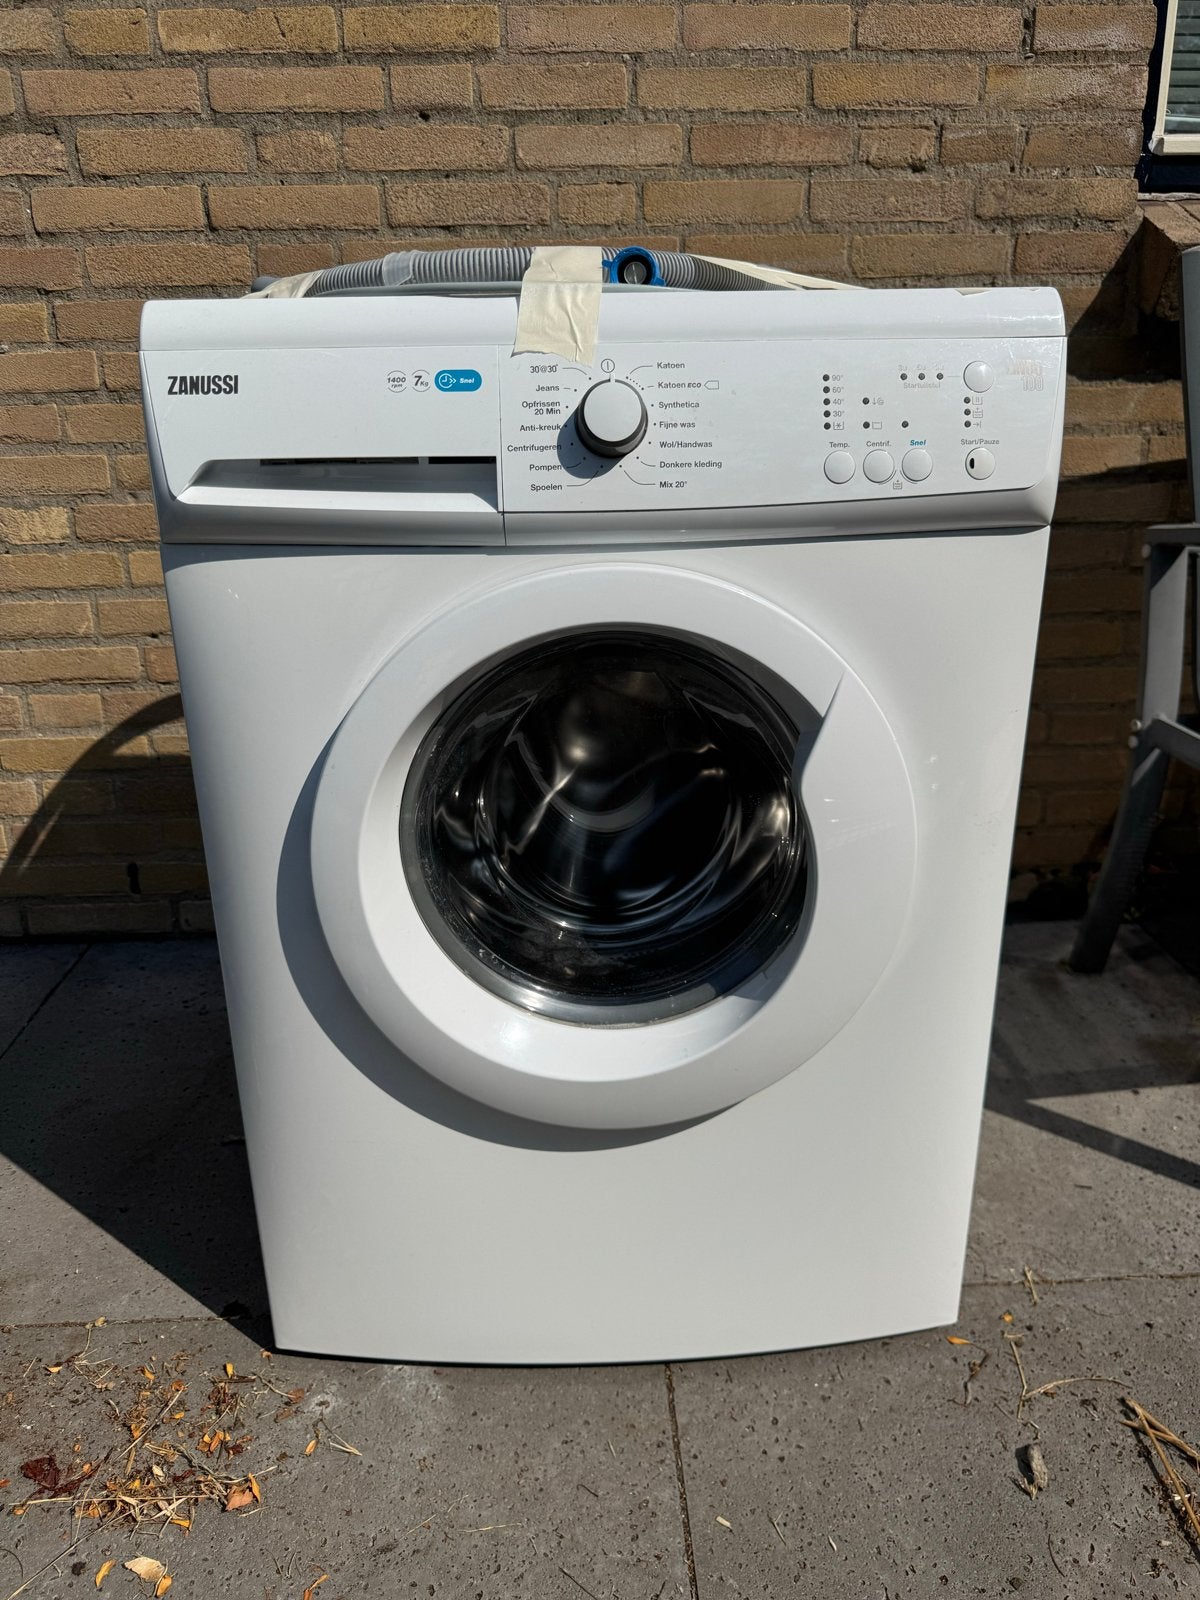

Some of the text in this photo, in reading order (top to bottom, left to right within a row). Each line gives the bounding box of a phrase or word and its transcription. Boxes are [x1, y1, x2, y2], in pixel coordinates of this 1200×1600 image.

[168, 375, 239, 395] ZANUSSI
[522, 400, 560, 409] Opfrissen
[658, 401, 700, 409] Synthetica
[520, 424, 561, 432] Anti-kreuk
[659, 421, 677, 429] Fijne
[507, 443, 562, 452] Centrifugeren
[529, 464, 562, 472] Pompen
[694, 460, 722, 470] kleding
[530, 483, 562, 492] Spoelen
